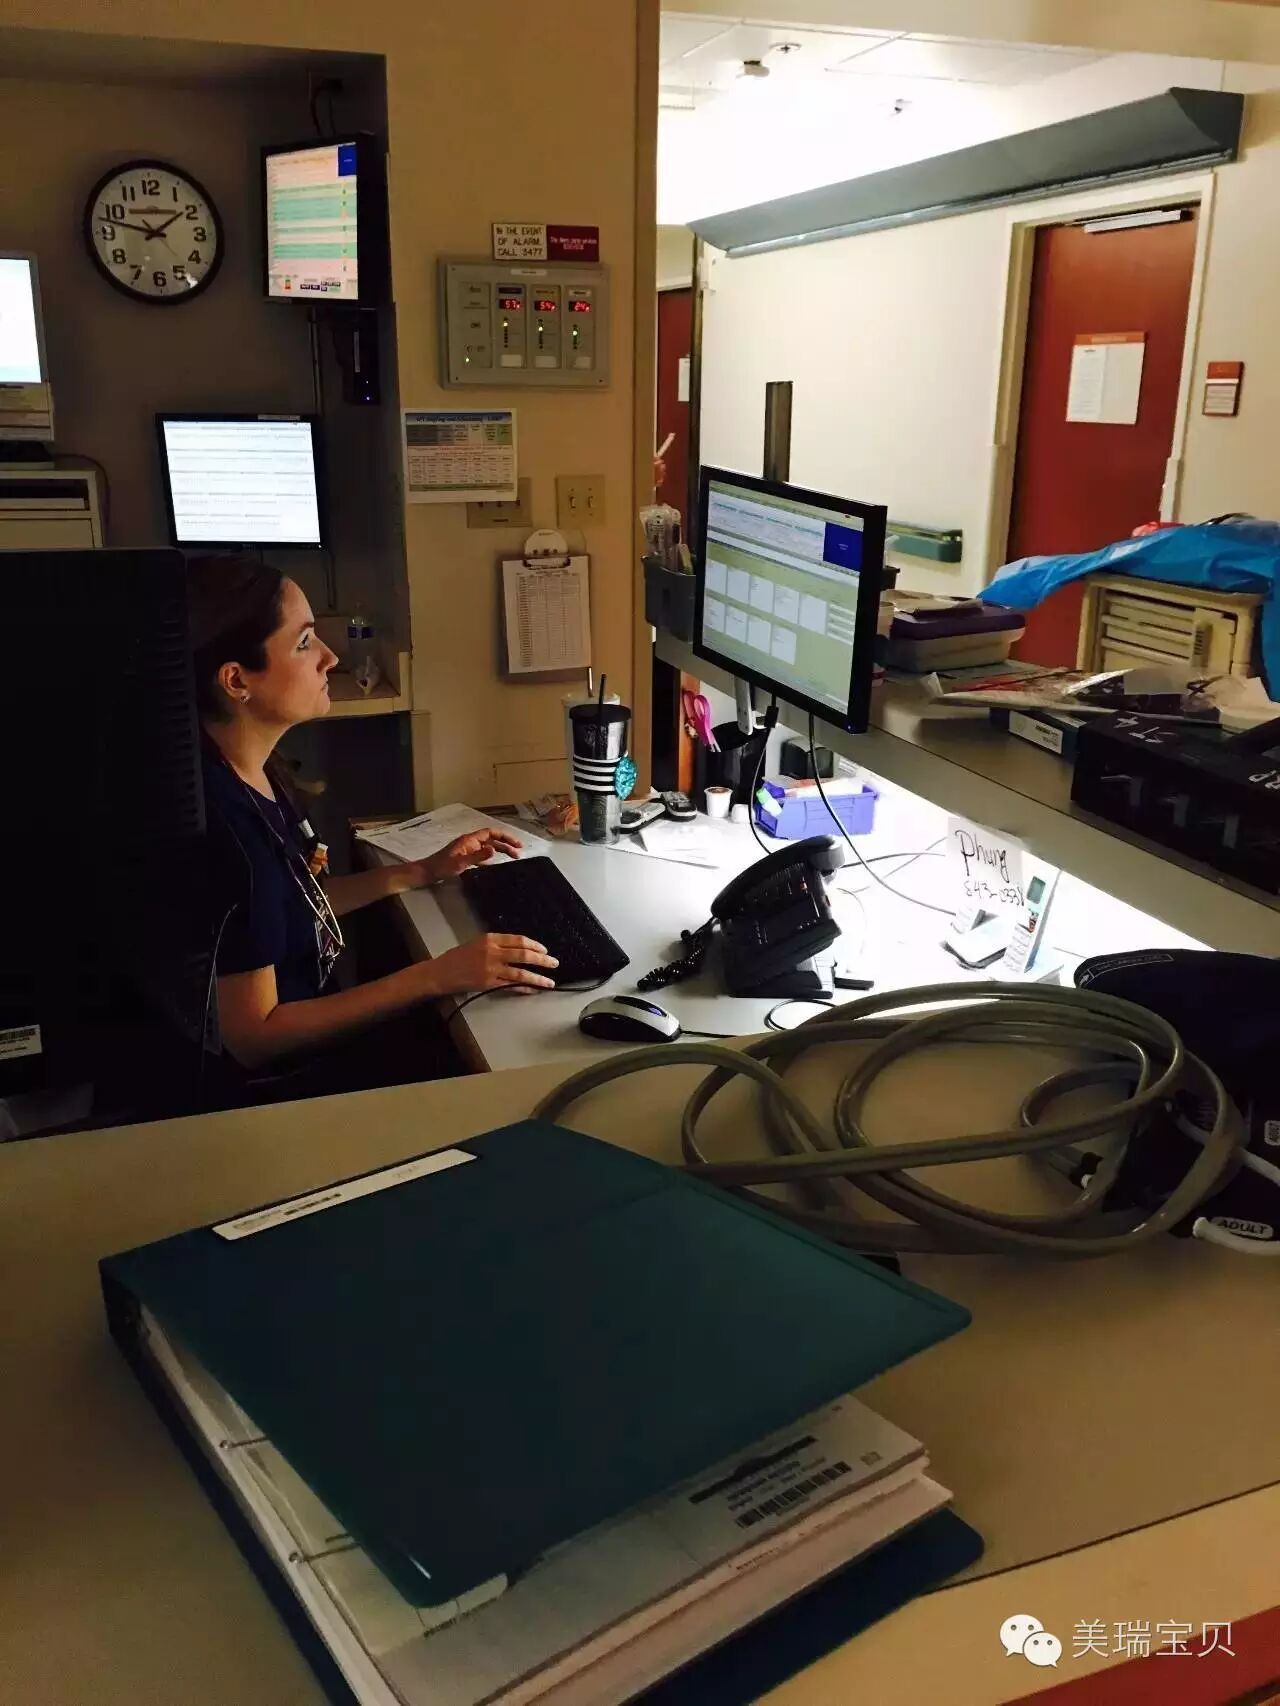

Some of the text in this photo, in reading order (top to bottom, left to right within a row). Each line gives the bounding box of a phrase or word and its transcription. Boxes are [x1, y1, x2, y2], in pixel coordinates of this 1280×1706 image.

[122, 185, 136, 202] 11
[141, 179, 160, 196] 12
[172, 186, 179, 203] 1
[105, 204, 125, 220] 10
[185, 204, 199, 221] 2
[101, 224, 116, 242] 9
[192, 226, 207, 243] 3
[112, 248, 126, 265] 8
[187, 250, 201, 265] 4
[129, 263, 143, 281] 7
[152, 270, 167, 288] 6
[172, 264, 186, 281] 5
[1217, 1219, 1268, 1235] ADULT
